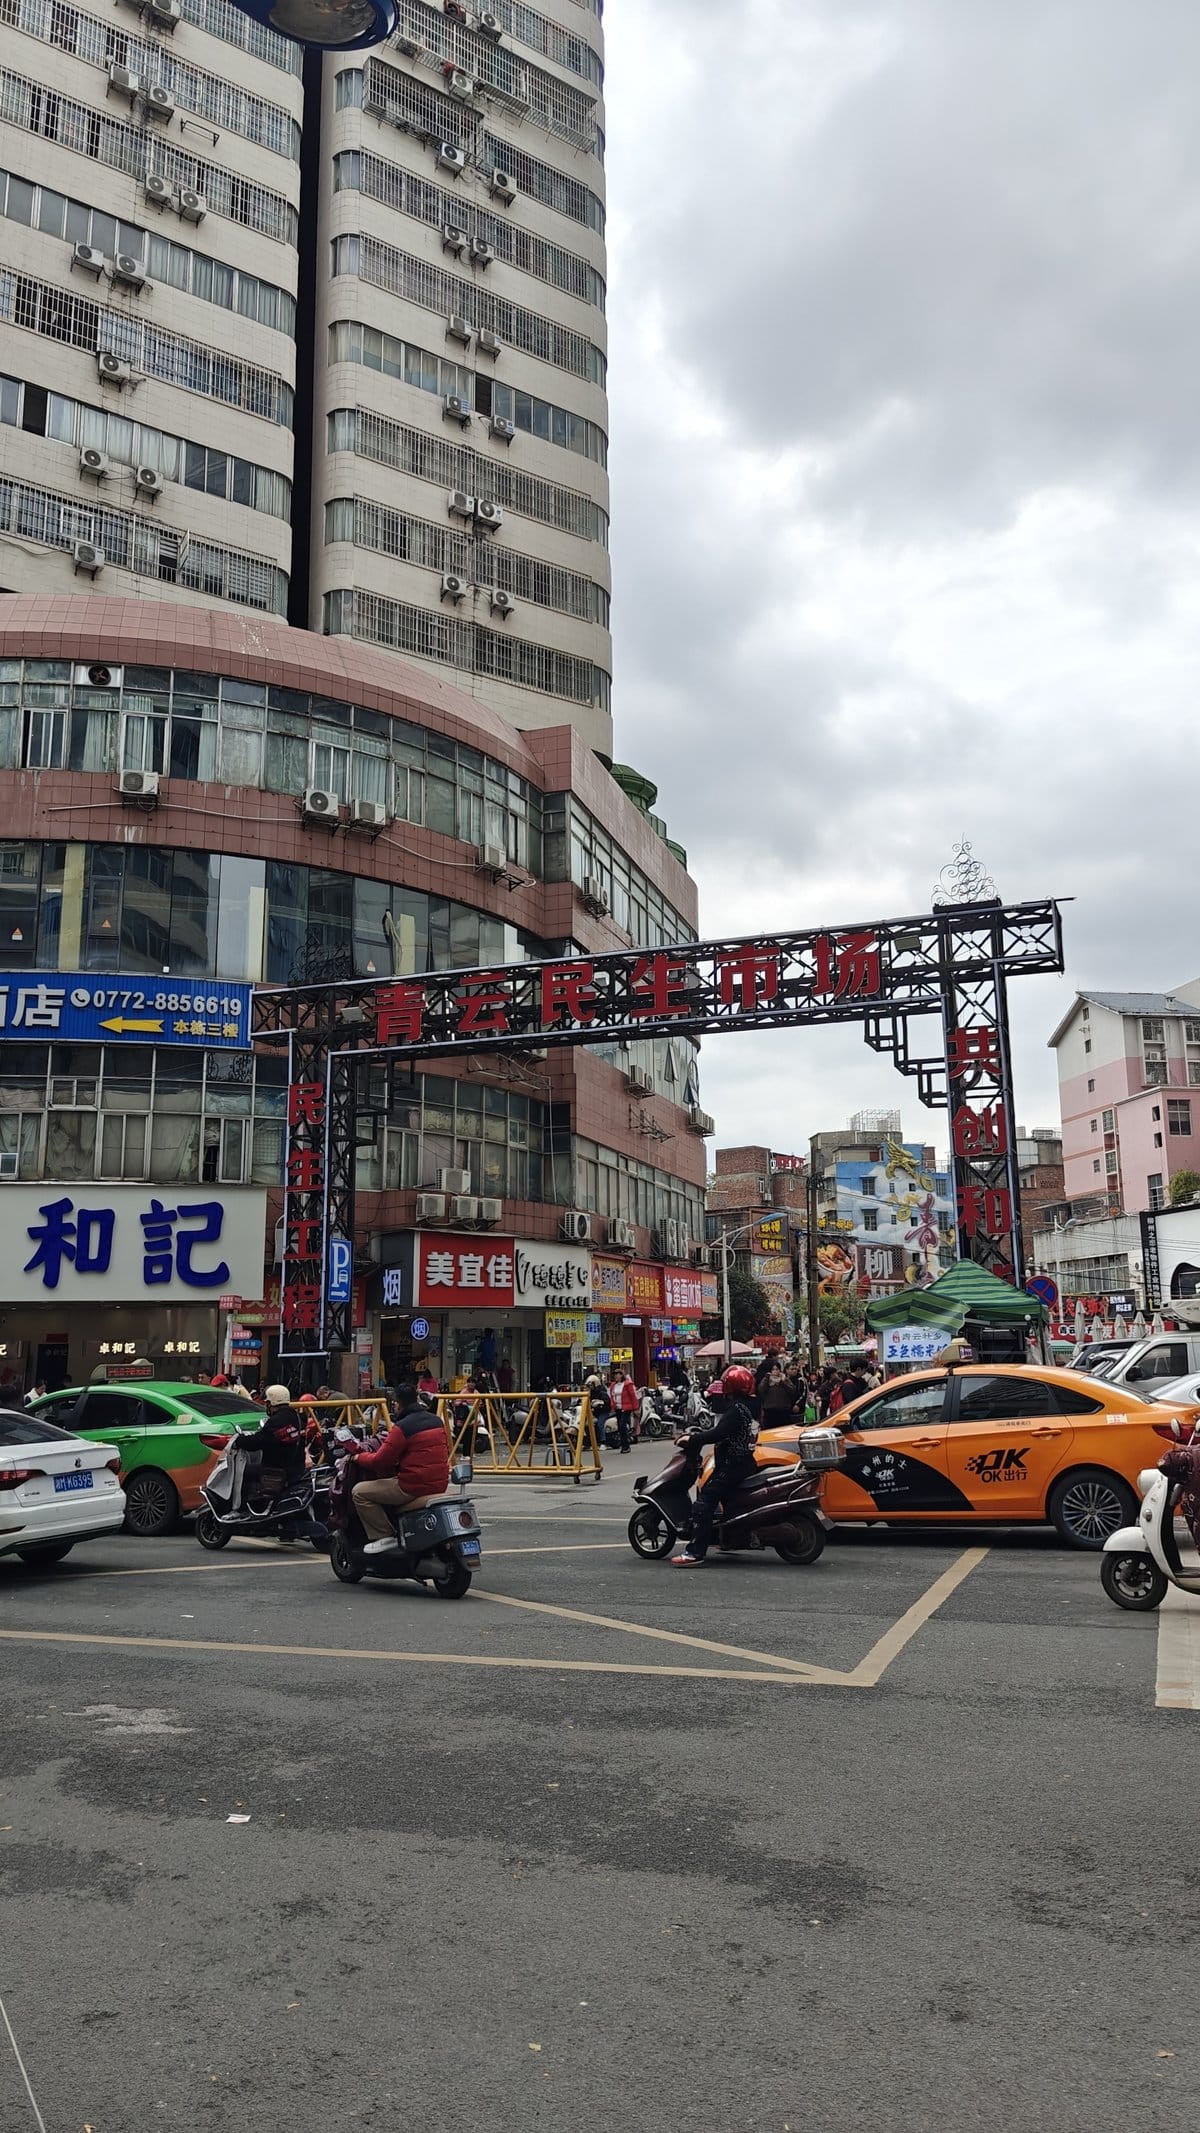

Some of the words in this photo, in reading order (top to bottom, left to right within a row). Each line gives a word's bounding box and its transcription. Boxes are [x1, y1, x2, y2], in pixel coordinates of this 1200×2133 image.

[94, 990, 242, 1016] 0772-8856619
[375, 933, 881, 1044] 青云民生市场
[0, 984, 66, 1027] 店
[173, 1019, 239, 1038] 本栋三楼
[283, 1082, 325, 1329] 民生工程
[24, 1197, 230, 1289] 和記
[425, 1251, 513, 1288] 美宜佳
[383, 1269, 401, 1306] 烟
[413, 1321, 426, 1337] 烟
[861, 1454, 907, 1477] 柳州的士
[979, 1448, 1031, 1471] OK
[981, 1470, 1002, 1483] OK
[1004, 1468, 1028, 1481] 出行
